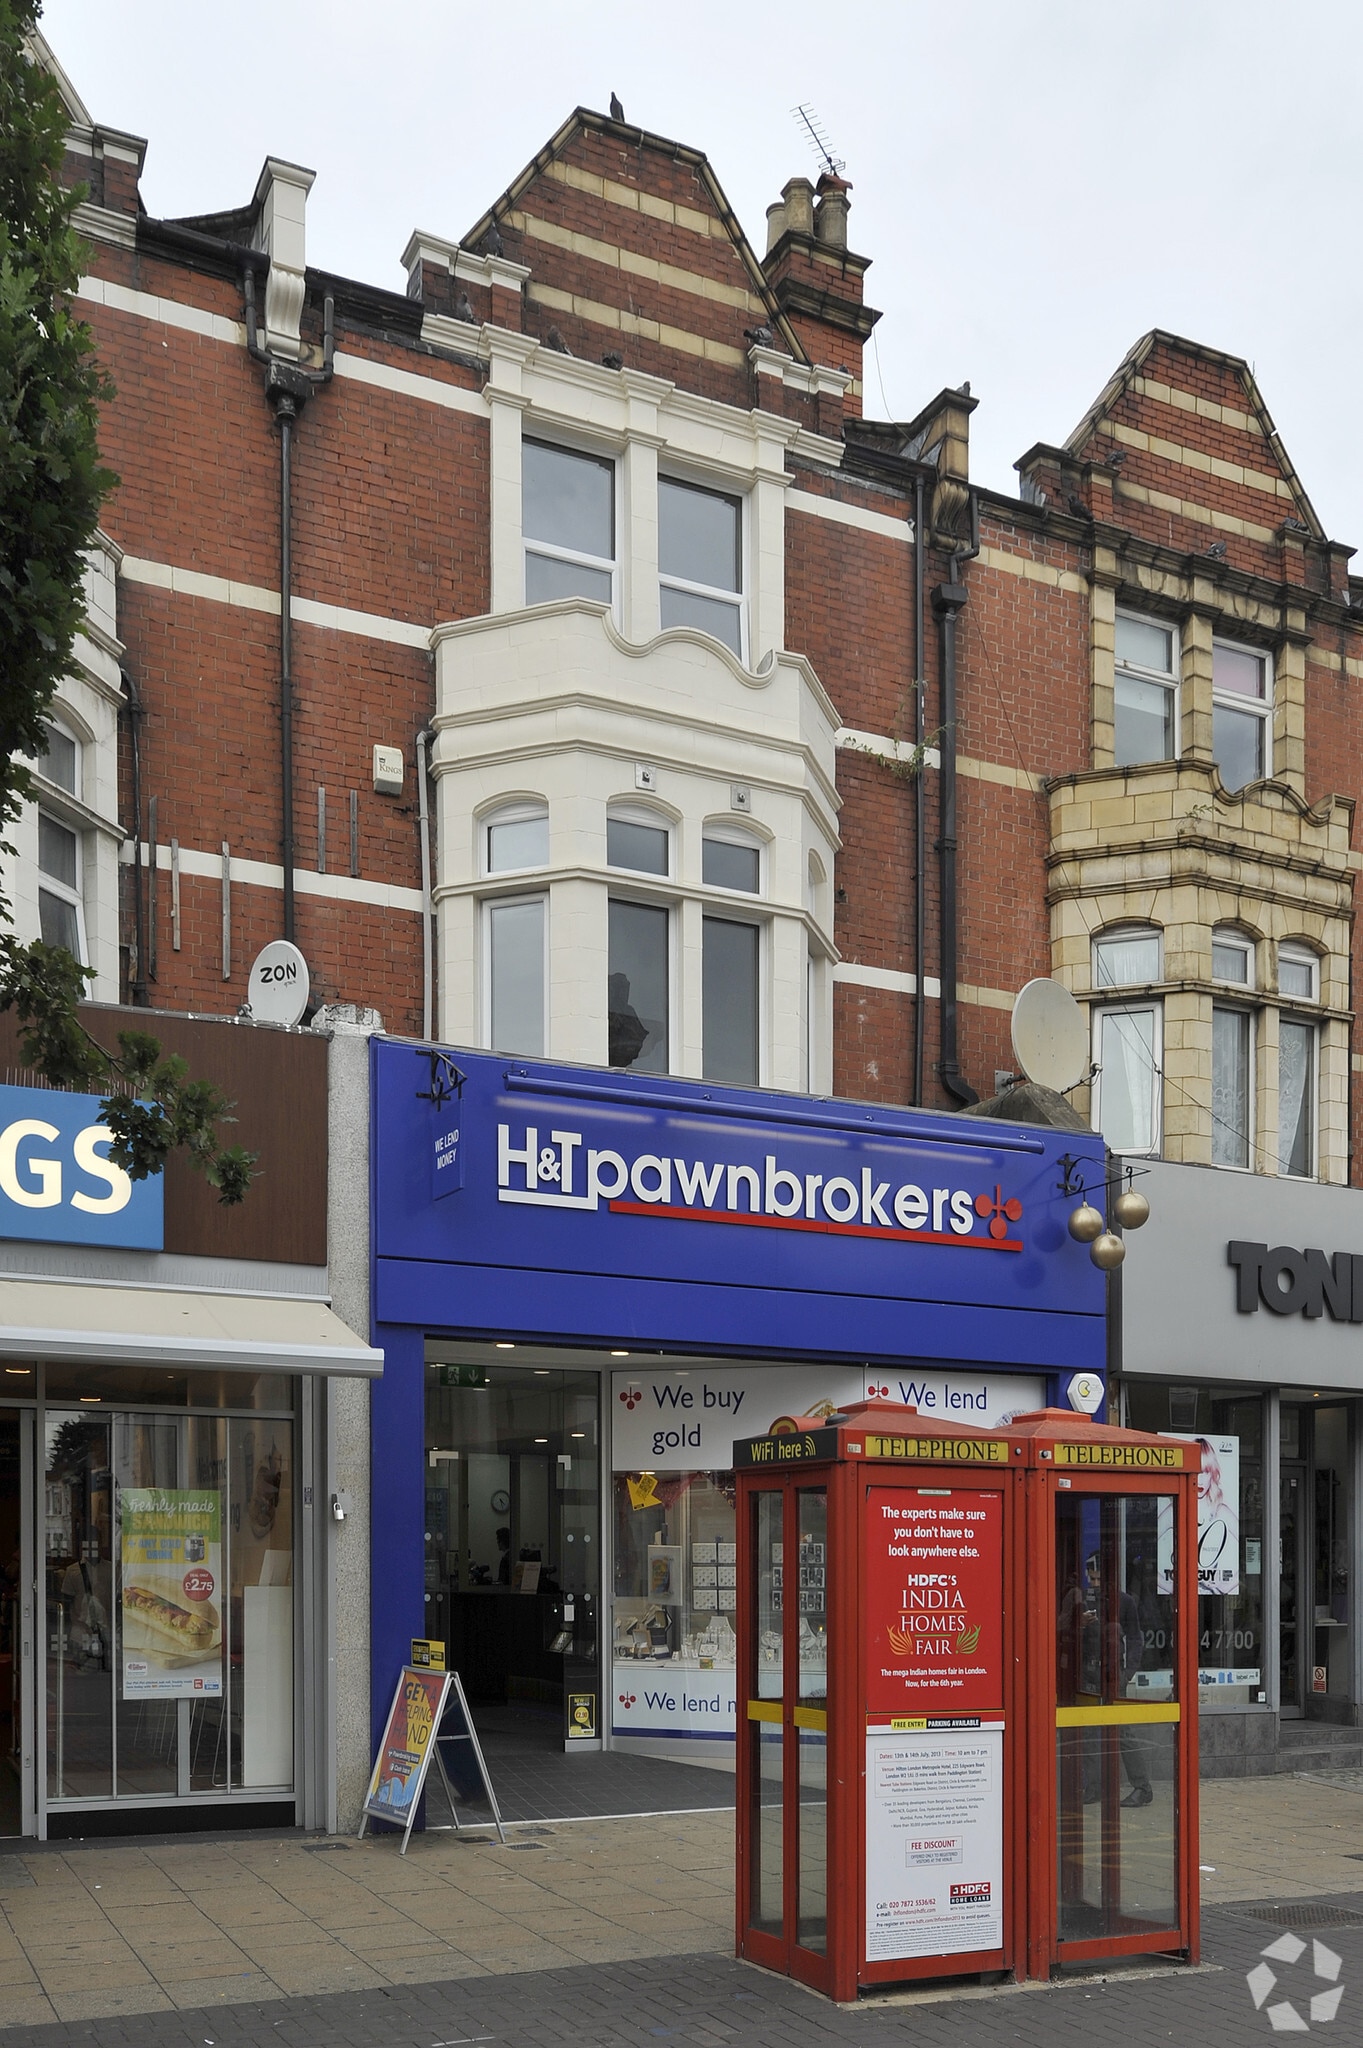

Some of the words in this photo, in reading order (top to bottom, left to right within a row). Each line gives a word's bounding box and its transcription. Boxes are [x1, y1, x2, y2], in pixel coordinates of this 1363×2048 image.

[260, 962, 296, 983] ZON
[435, 1137, 444, 1153] WE
[444, 1129, 460, 1148] LEND
[437, 1148, 456, 1170] MONEY
[498, 1124, 582, 1193] H&T
[587, 1149, 974, 1235] pawnbrokers
[652, 1384, 695, 1409] We
[703, 1384, 745, 1415] buy
[898, 1381, 939, 1409] We
[944, 1384, 988, 1410] lend
[652, 1424, 701, 1457] gold
[752, 1440, 774, 1461] WiFi
[778, 1440, 802, 1459] here
[875, 1438, 999, 1461] TELEPHONE
[1063, 1445, 1175, 1466] TELEPHONE
[178, 1500, 216, 1512] made
[881, 1506, 900, 1518] The
[902, 1508, 937, 1521] experts
[939, 1508, 964, 1520] make
[966, 1510, 986, 1520] sure
[894, 1528, 912, 1540] you
[914, 1526, 938, 1538] don't
[940, 1526, 962, 1538] have
[964, 1528, 974, 1538] to
[888, 1544, 909, 1556] look
[911, 1545, 957, 1559] anywhere
[959, 1546, 980, 1557] else.
[185, 1579, 213, 1591] £2.75
[902, 1589, 965, 1608] INDIA
[902, 1615, 965, 1632] HOMES
[916, 1640, 952, 1654] FAIR
[1215, 1630, 1254, 1649] 7700
[910, 1668, 927, 1676] Indian
[948, 1667, 958, 1675] fair
[404, 1681, 430, 1702] GET
[430, 1686, 437, 1700] A
[906, 1680, 920, 1688] Now,
[950, 1680, 964, 1688] year.
[399, 1702, 432, 1722] HELPING
[644, 1692, 676, 1711] We
[683, 1693, 720, 1712] lend
[393, 1723, 428, 1745] HAND
[911, 1842, 922, 1850] FEE
[924, 1840, 956, 1849] DISCOUNT
[960, 1884, 989, 1894] HDFC
